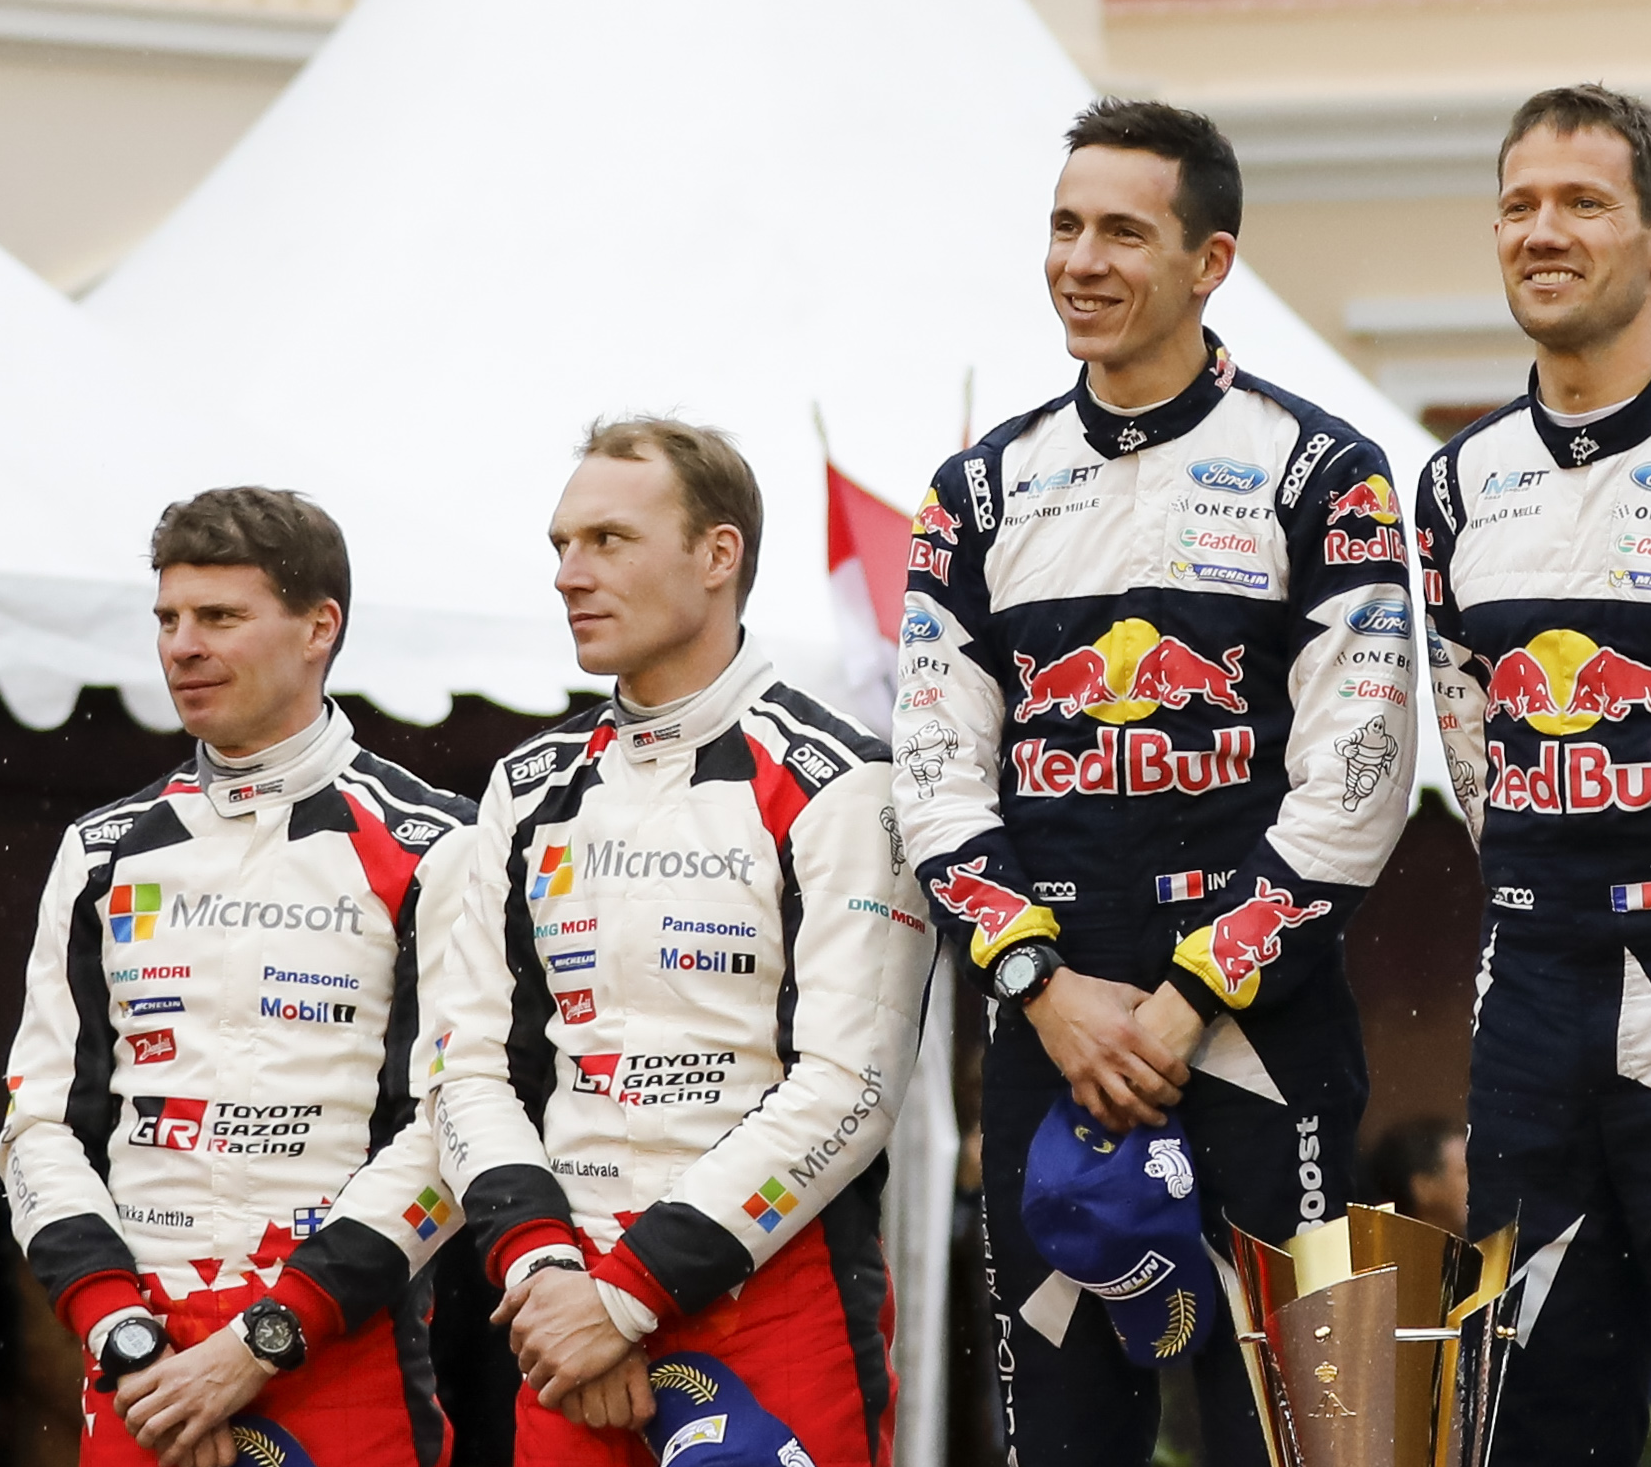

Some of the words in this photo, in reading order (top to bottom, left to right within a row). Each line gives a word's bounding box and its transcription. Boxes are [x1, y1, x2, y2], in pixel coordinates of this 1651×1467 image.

[1200, 463, 1260, 489] Ford
[1282, 432, 1330, 507] sparco
[965, 458, 996, 530] sparco
[1195, 503, 1274, 521] ONEBET
[1199, 530, 1258, 554] Castrol
[1325, 528, 1389, 565] Red
[1200, 566, 1268, 588] MICHELIN
[1362, 604, 1410, 633] Ford
[1353, 651, 1412, 675] ONEBE
[512, 750, 558, 780] OMP
[793, 747, 836, 781] OMP
[1012, 727, 1122, 798] Red
[1125, 726, 1255, 798] Bull
[396, 822, 441, 841] OMP
[584, 839, 756, 886] Microsoft
[171, 892, 365, 937] Microsoft
[662, 916, 757, 938] Panasonic
[848, 899, 890, 919] DMG
[891, 910, 926, 934] MORI
[141, 966, 191, 980] MORI
[660, 948, 727, 974] Mobil
[264, 966, 359, 991] Panasonic
[260, 997, 329, 1024] Mobil
[626, 1052, 736, 1069] TOYOTA
[623, 1071, 725, 1087] GAZOO
[618, 1088, 721, 1106] Racing
[214, 1103, 323, 1119] TOYOTA
[129, 1108, 203, 1150] GR
[213, 1121, 311, 1136] GAZOO
[789, 1063, 884, 1189] Microsoft
[206, 1138, 306, 1157] Racing
[578, 1160, 619, 1179] Latvala
[1296, 1115, 1326, 1235] Boost
[146, 1210, 195, 1228] Anttila
